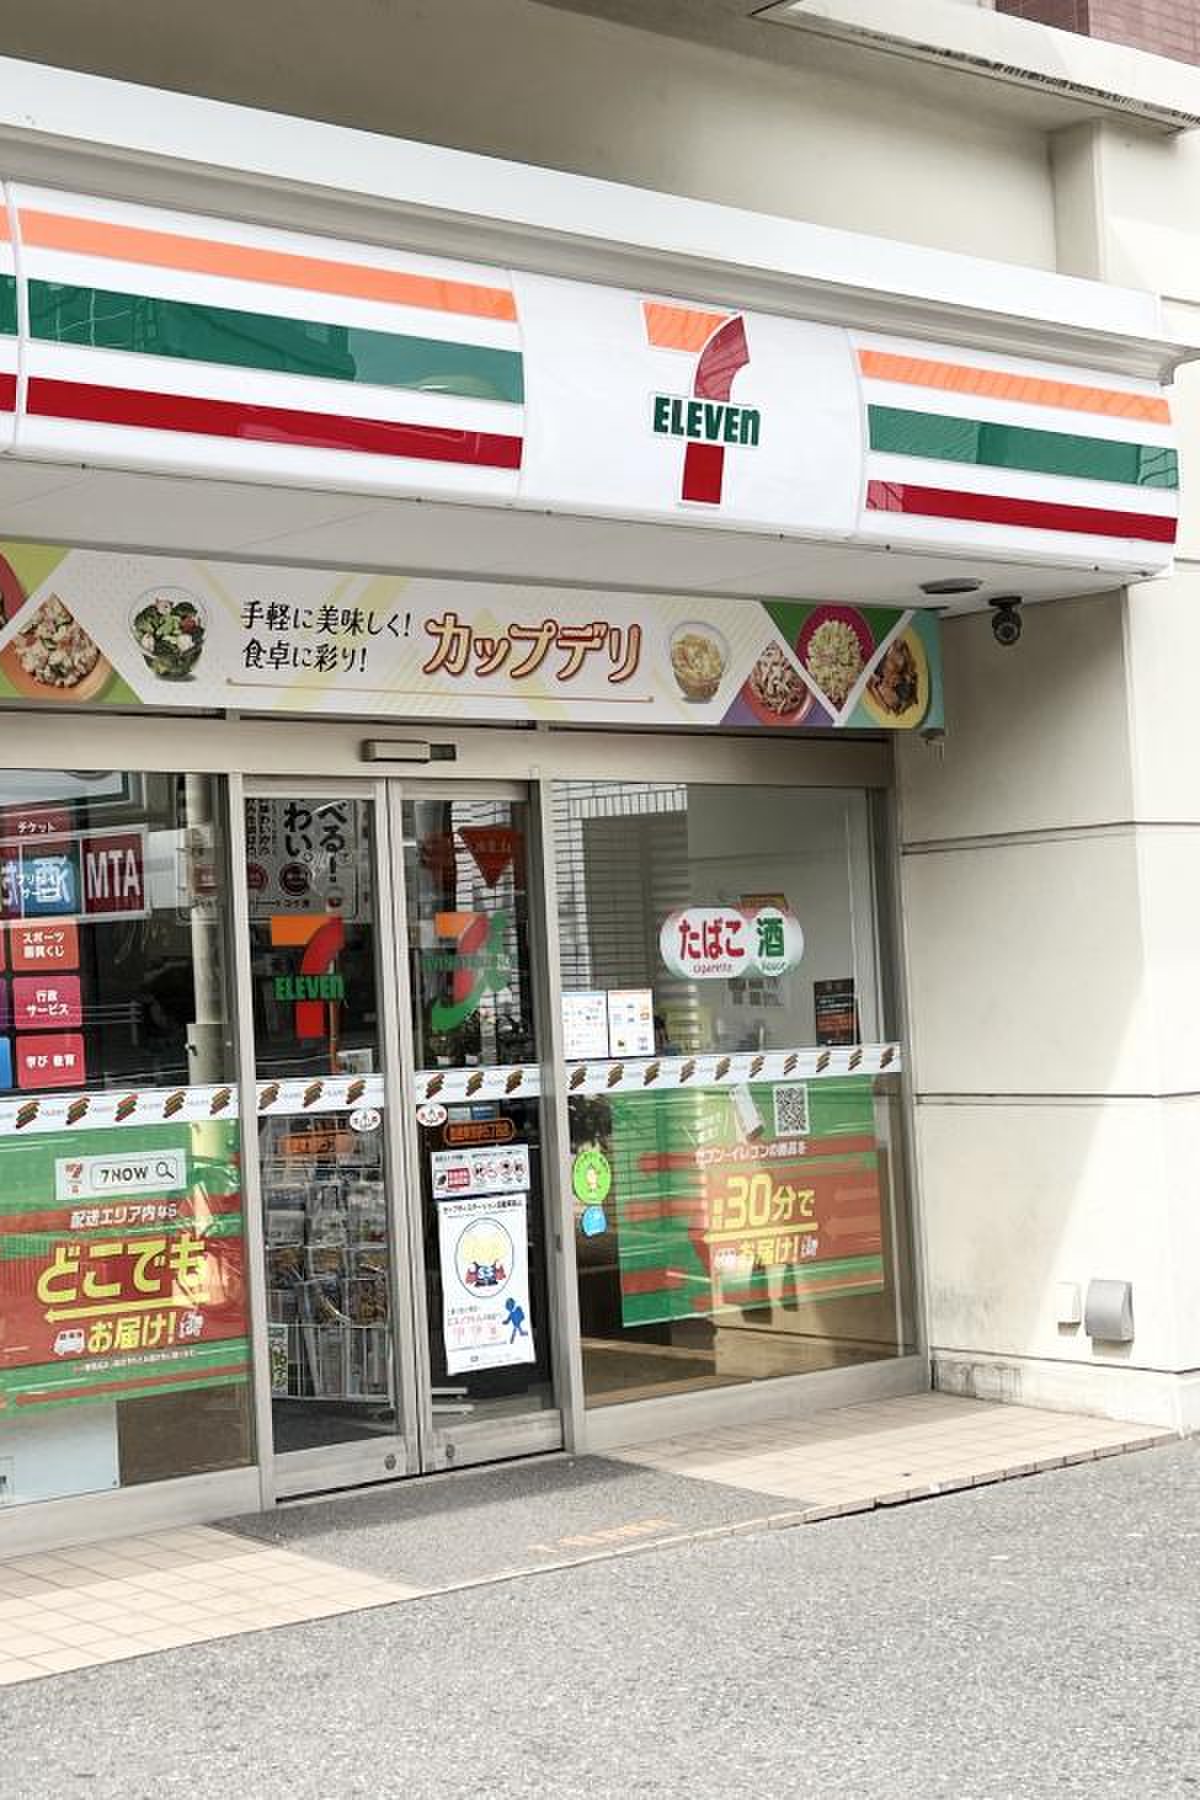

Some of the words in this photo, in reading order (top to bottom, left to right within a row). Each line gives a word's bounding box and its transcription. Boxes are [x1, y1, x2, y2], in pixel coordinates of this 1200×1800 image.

[240, 600, 413, 637] 手軽に美味しく!
[242, 638, 367, 672] 食卓に彩り!
[422, 613, 641, 682] カップデリ
[679, 917, 745, 960] たばこ
[757, 917, 785, 957] 酒
[37, 1232, 208, 1304] どこでも
